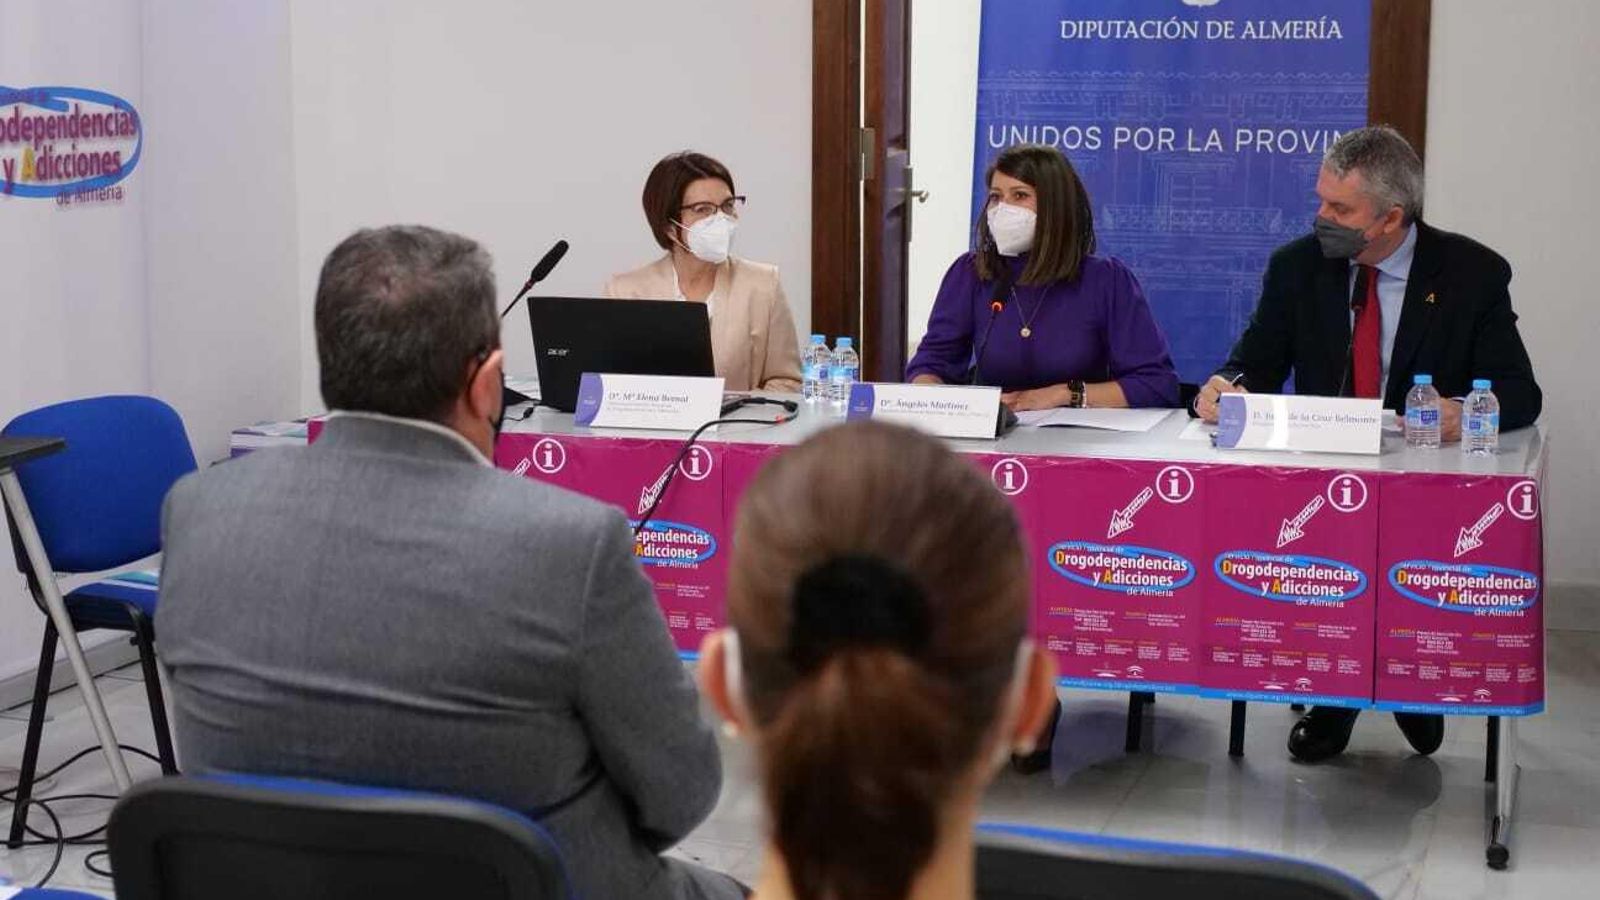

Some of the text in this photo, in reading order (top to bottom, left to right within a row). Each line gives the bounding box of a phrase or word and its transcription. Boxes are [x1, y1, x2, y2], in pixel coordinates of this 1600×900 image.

[1060, 16, 1343, 40] DIPUTACIÓN DE ALMERÍA
[989, 125, 1101, 149] UNIDOS
[1114, 127, 1176, 151] POR
[1187, 128, 1223, 152] LA
[3, 143, 122, 194] y Adicciones
[635, 543, 698, 559] Adicciones
[1056, 550, 1188, 572] Drogodependencias
[1093, 569, 1174, 587] y Adicciones
[1222, 560, 1359, 583] Drogodependencias
[1397, 569, 1537, 590] Drogodependencias
[1261, 579, 1344, 597] y Adicciones
[1438, 588, 1524, 607] y Adicciones
